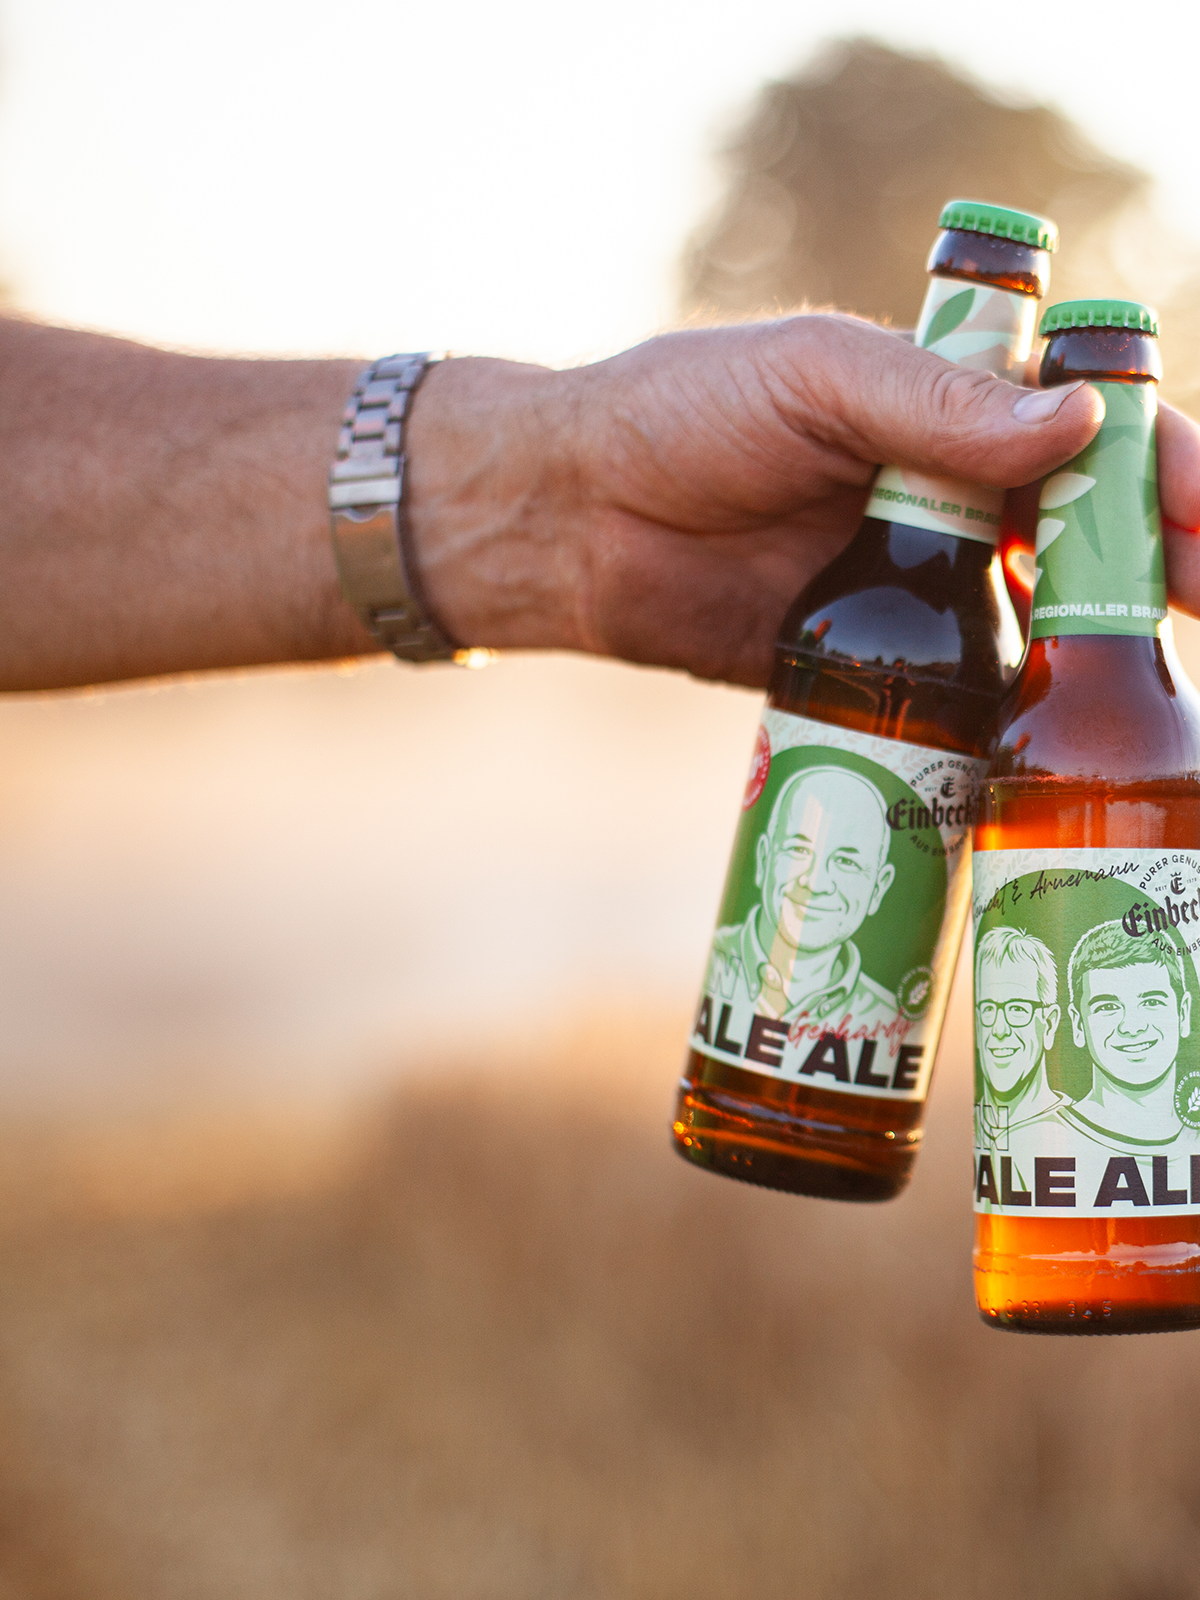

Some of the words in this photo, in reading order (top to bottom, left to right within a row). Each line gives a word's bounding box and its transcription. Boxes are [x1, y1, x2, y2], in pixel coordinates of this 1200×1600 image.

[873, 487, 961, 517] REGIONALER
[1034, 604, 1128, 621] REGIONALER
[910, 760, 944, 788] PURER
[910, 835, 930, 853] AUS
[1029, 862, 1140, 900] Arnemann
[1139, 857, 1169, 890] PURER
[1151, 937, 1173, 955] AUS
[798, 1031, 926, 1090] ALE
[976, 1154, 1077, 1208] ALE
